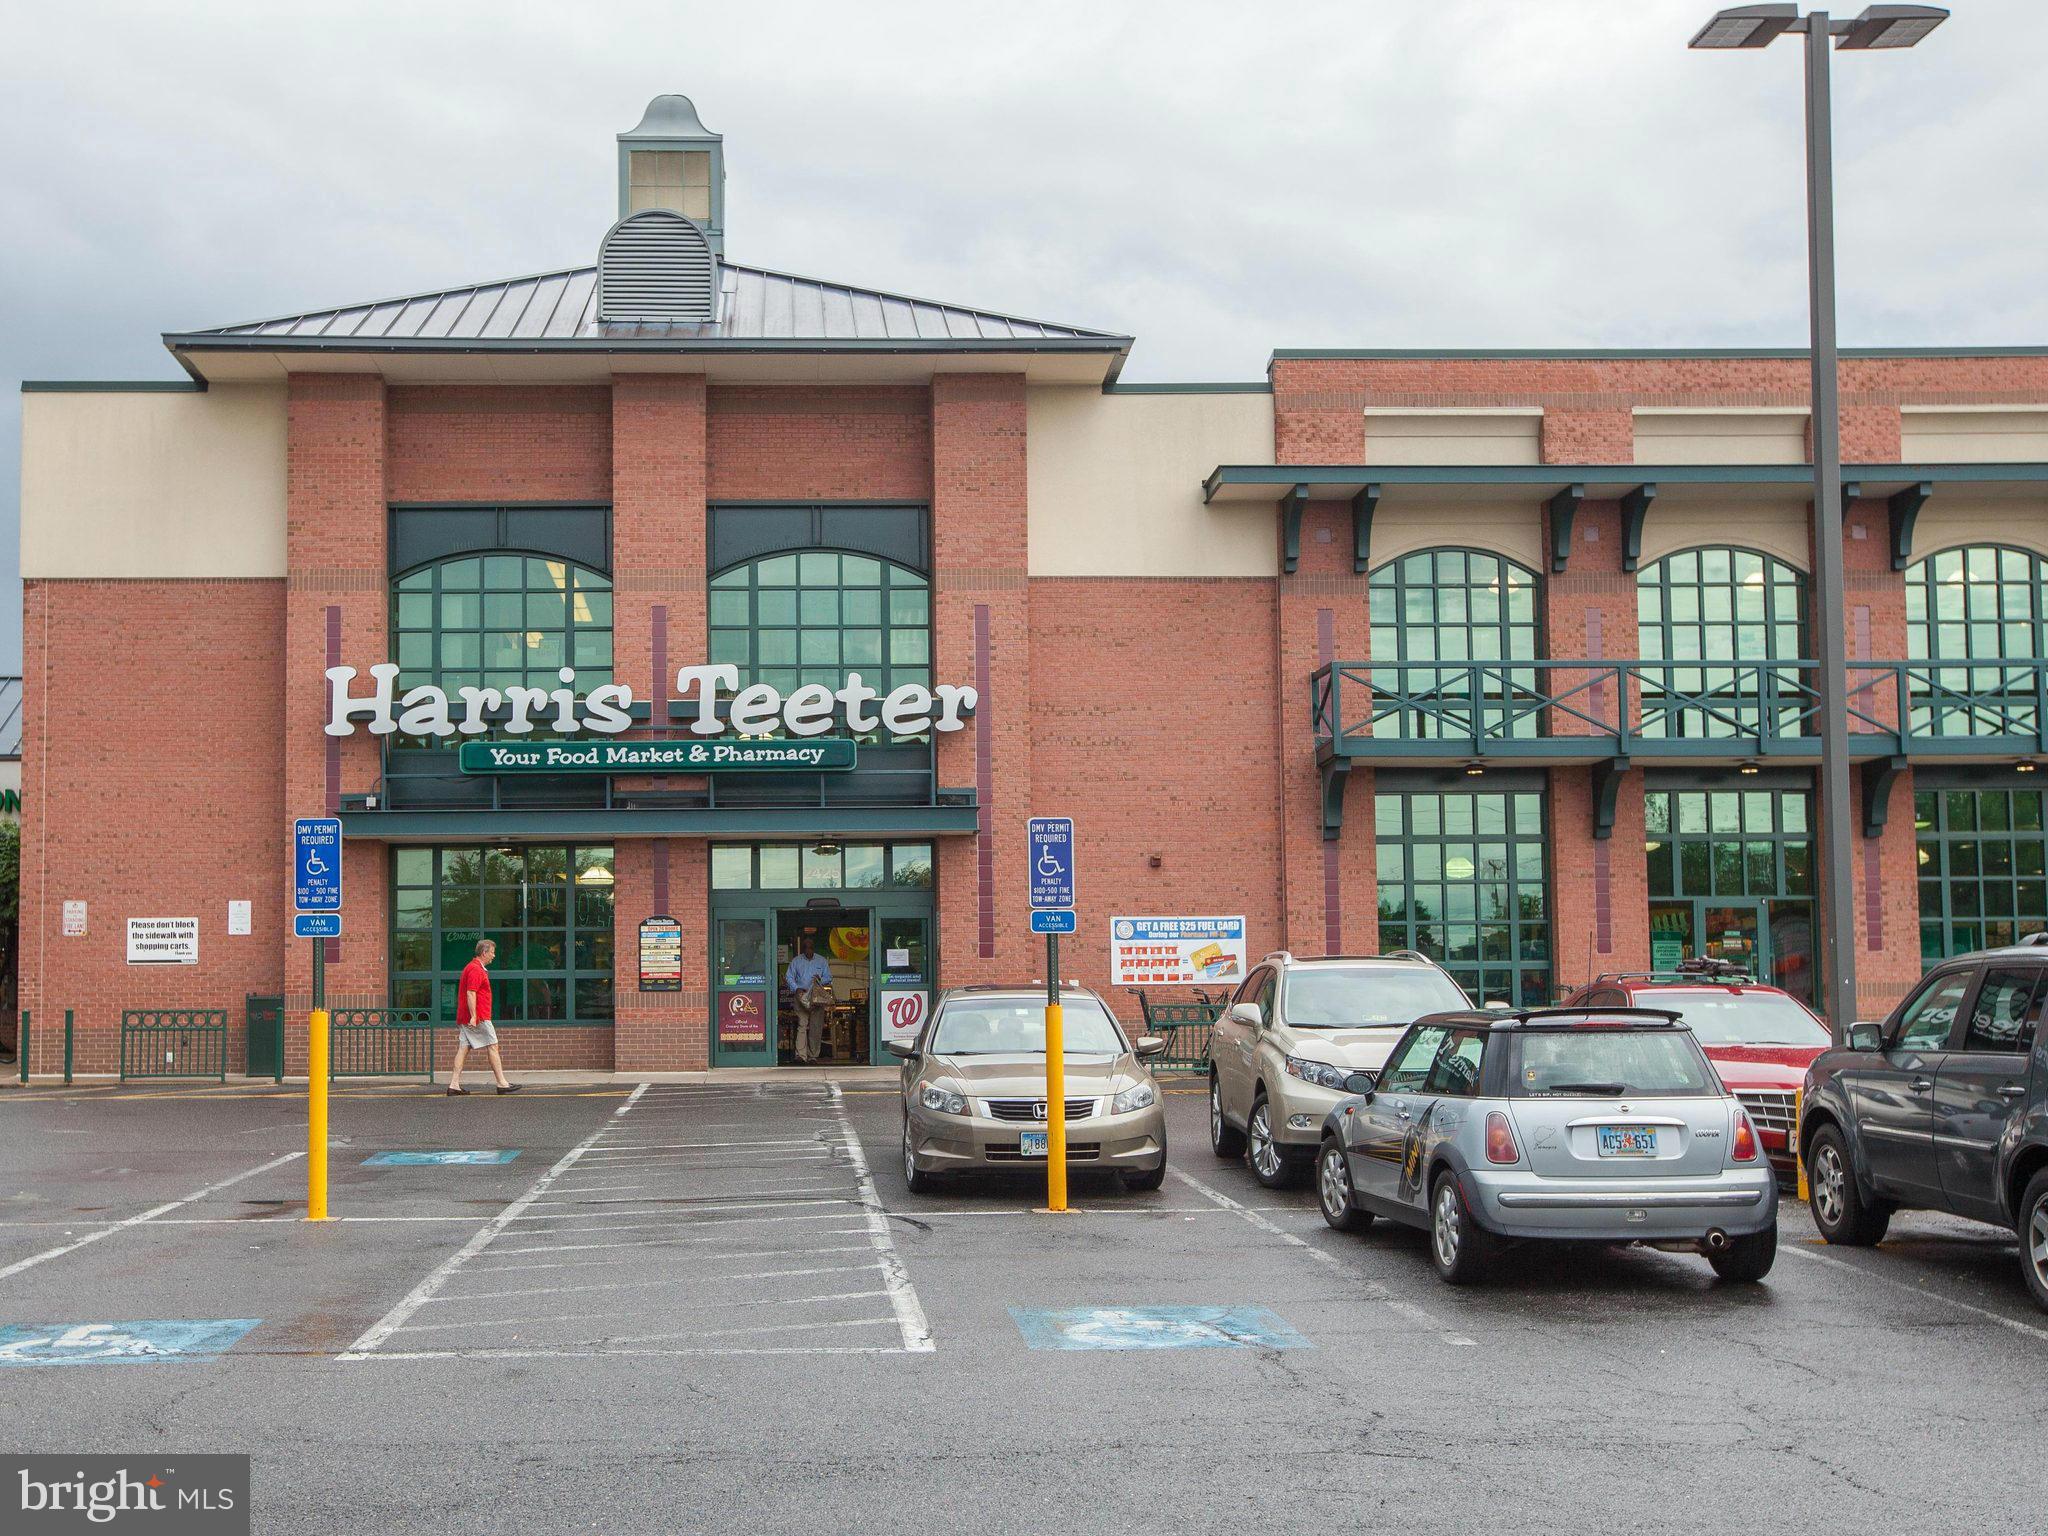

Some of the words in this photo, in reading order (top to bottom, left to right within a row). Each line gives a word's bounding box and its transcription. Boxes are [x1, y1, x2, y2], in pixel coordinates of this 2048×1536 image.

[324, 663, 634, 737] Harris
[676, 663, 979, 737] Teeter
[490, 748, 541, 766] Your
[546, 749, 599, 765] Food
[606, 747, 684, 764] Market
[688, 745, 708, 763] &
[713, 745, 825, 764] Pharmacy
[297, 825, 312, 835] DMV
[314, 825, 338, 834] PERMIT
[1031, 823, 1045, 833] DMV
[1047, 823, 1070, 832] PERMIT
[301, 835, 335, 845] REQUIRED
[1035, 834, 1067, 843] REQUIRED
[324, 895, 338, 903] ZONE
[131, 921, 155, 929] Please
[1136, 921, 1152, 931] GET
[1152, 921, 1159, 931] A
[1159, 921, 1179, 931] FREE
[1179, 921, 1197, 931] $25
[1197, 921, 1216, 931] FUEL
[1217, 920, 1240, 931] CARD
[178, 931, 194, 939] with
[135, 943, 169, 951] shopping
[1695, 1129, 1720, 1138] COOPER
[1635, 1134, 1655, 1149] 651
[1406, 1136, 1419, 1180] MINI
